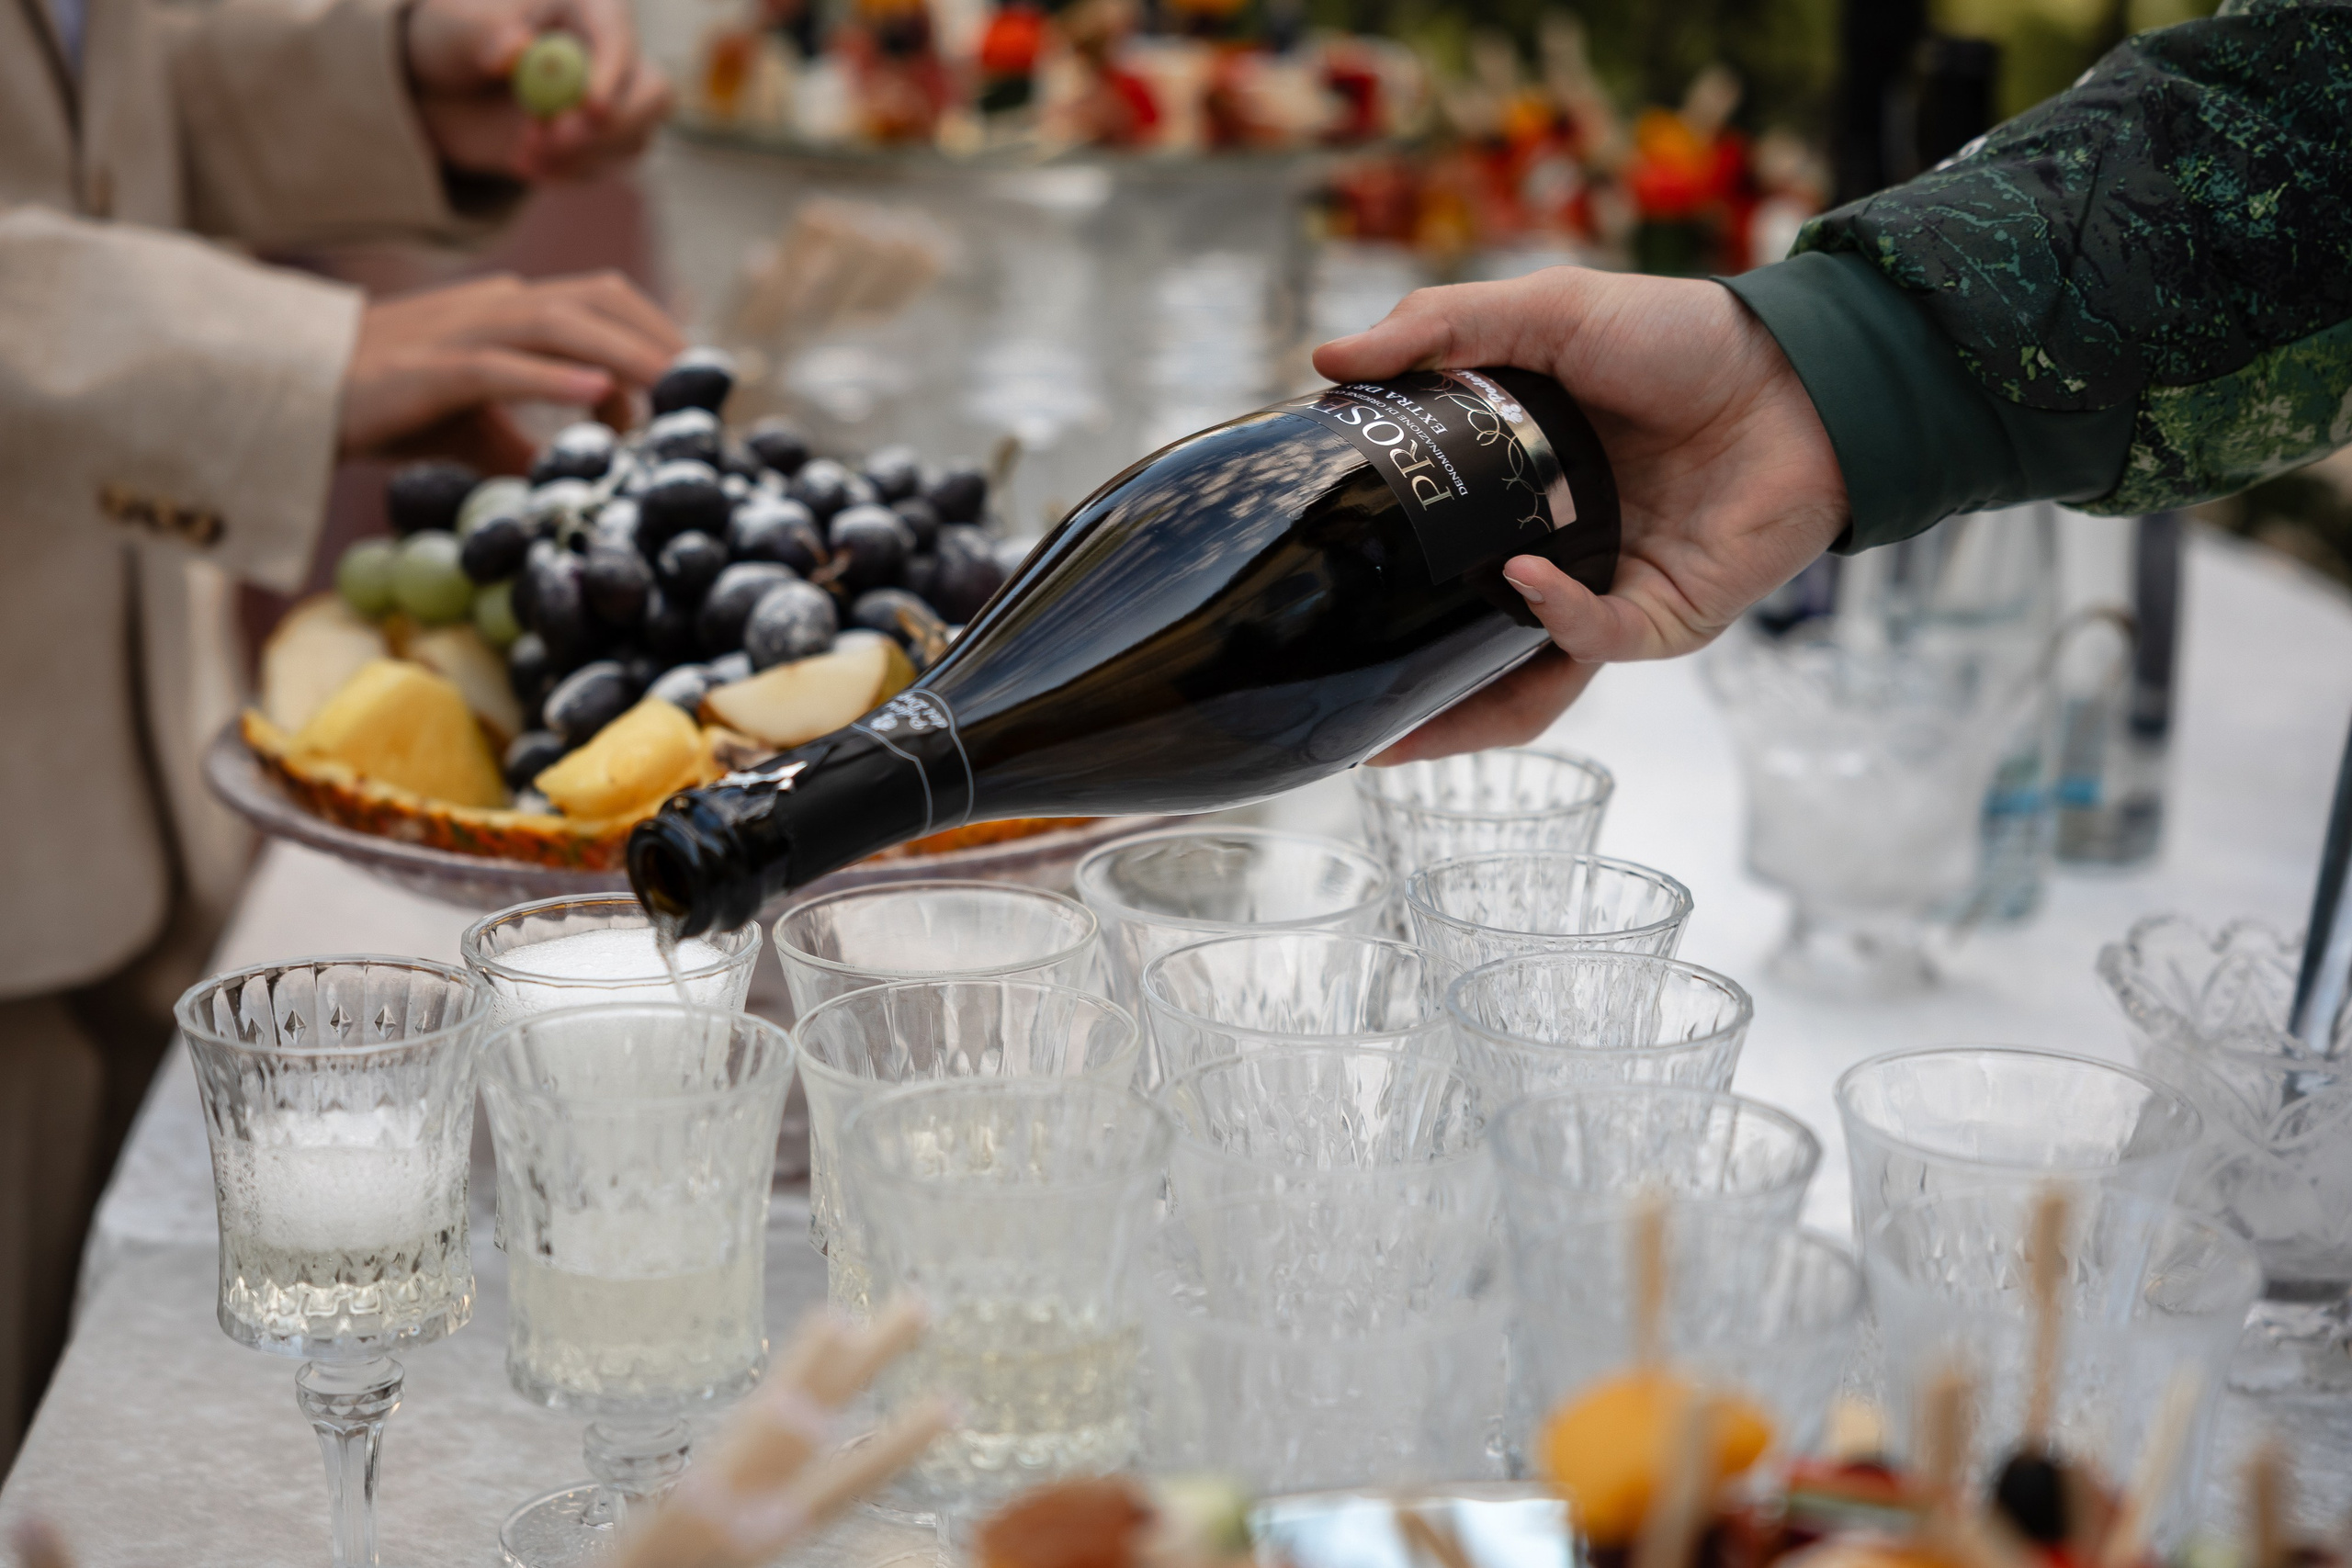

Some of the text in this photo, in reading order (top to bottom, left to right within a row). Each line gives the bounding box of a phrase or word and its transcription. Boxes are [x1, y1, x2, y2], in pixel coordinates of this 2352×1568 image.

[1385, 407, 1399, 415] DI
[1385, 391, 1448, 434] EXTRA
[1397, 414, 1468, 496] DENOMINAZIONE
